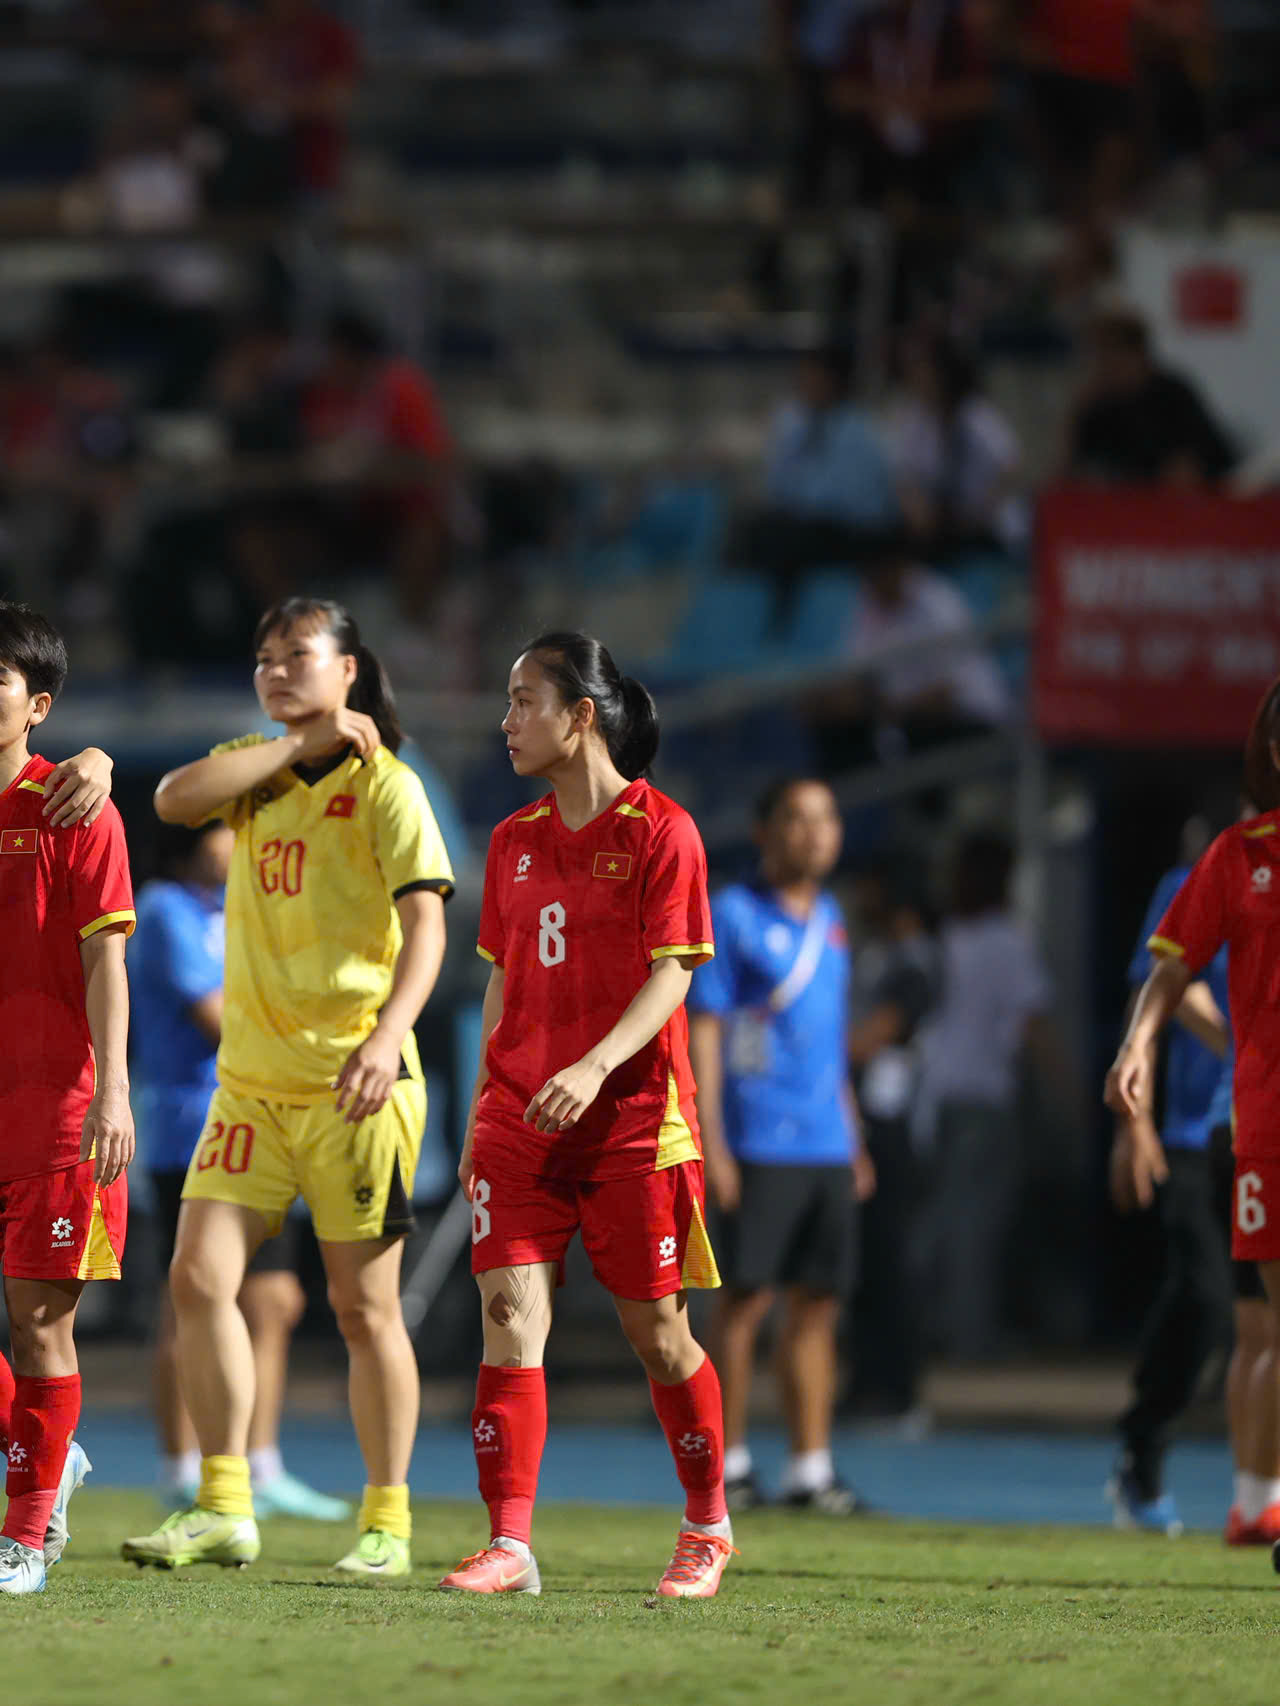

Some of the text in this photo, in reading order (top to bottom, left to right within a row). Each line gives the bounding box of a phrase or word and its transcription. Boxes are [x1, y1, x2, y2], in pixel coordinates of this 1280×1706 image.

[260, 838, 304, 895] 20
[538, 901, 567, 967] 8
[197, 1121, 254, 1175] 20
[471, 1178, 491, 1245] 8
[1237, 1172, 1266, 1234] 6
